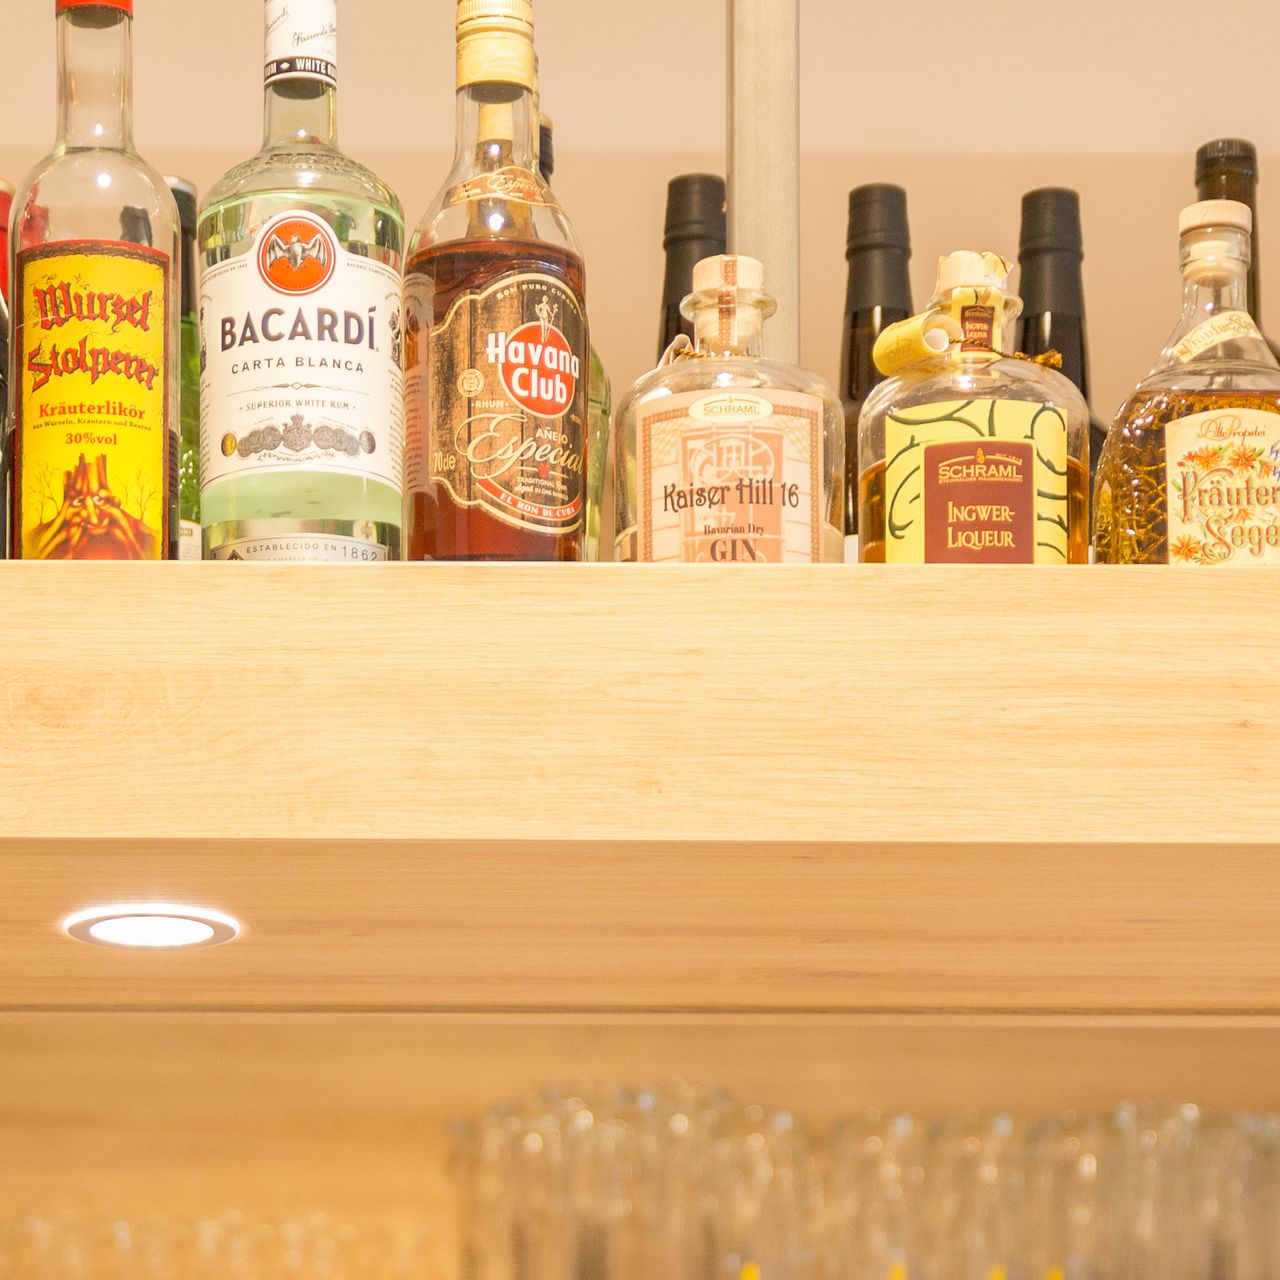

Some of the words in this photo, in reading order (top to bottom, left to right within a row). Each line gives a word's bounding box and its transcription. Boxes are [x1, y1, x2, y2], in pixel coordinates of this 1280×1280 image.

[296, 58, 326, 73] WHITE
[496, 287, 519, 300] RON
[522, 283, 548, 291] PURO
[31, 280, 153, 336] Wurzel
[221, 306, 376, 352] BACARDÍ
[486, 332, 580, 379] Havana
[232, 358, 285, 375] CARTA
[296, 357, 364, 373] BLANCA
[511, 367, 567, 404] Club
[38, 400, 146, 420] Kräuterlikör
[247, 399, 291, 411] SUPERIOR
[296, 399, 327, 408] WHITE
[330, 399, 349, 410] RUM
[704, 405, 761, 415] SCHRAML
[114, 418, 128, 427] und
[66, 432, 118, 445] 30%vol
[536, 427, 569, 444] AÑEJO
[454, 414, 583, 479] Especial
[938, 464, 1023, 479] SCHRAML
[664, 482, 731, 513] Kaiser
[736, 478, 774, 505] Hill
[781, 483, 799, 508] 16
[500, 492, 513, 505] EL
[516, 501, 539, 516] RON
[540, 508, 554, 519] DE
[948, 501, 1015, 524] INGWER-
[704, 524, 745, 535] Bavarian
[748, 524, 765, 537] Dry
[947, 527, 1016, 550] LIQUEUR
[247, 542, 318, 554] ESTABLECIDO
[324, 543, 337, 552] EN
[710, 540, 757, 562] GIN
